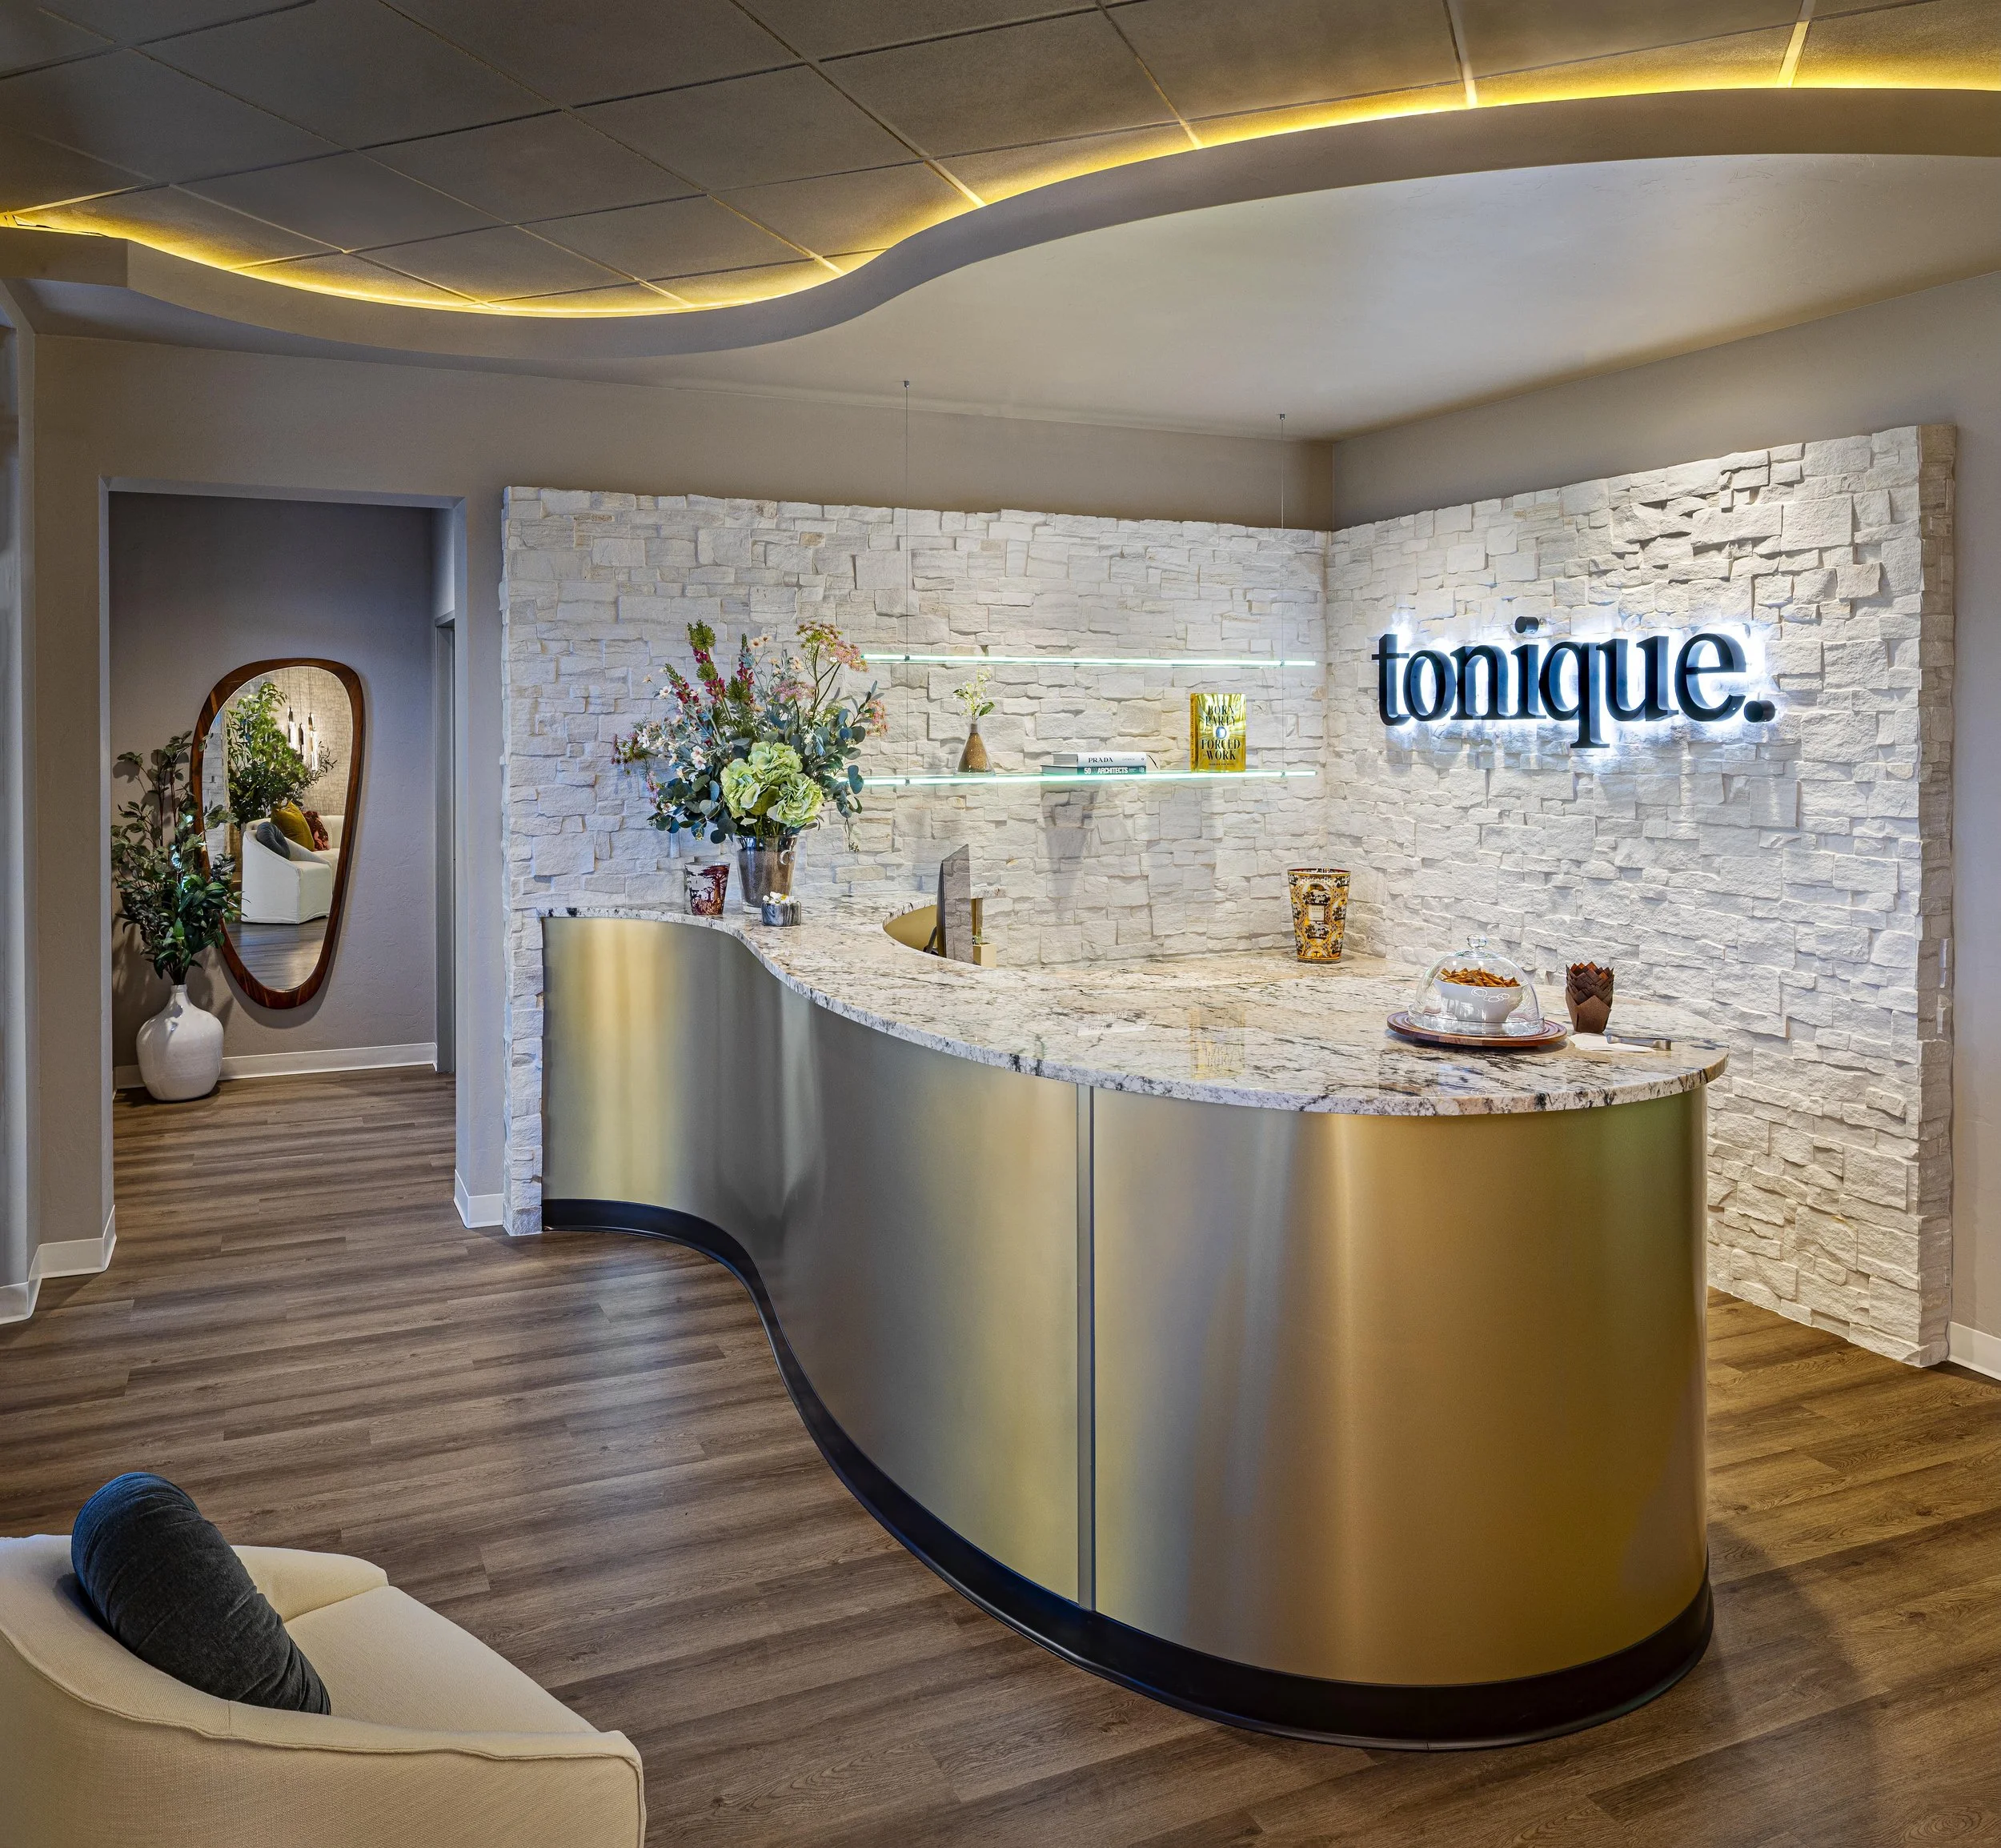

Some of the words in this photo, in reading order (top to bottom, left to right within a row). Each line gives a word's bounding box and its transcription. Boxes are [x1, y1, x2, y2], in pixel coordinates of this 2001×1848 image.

[1371, 616, 1778, 748] tonique.
[1208, 705, 1235, 716] BORN
[1205, 716, 1236, 726] PARTY
[1201, 739, 1241, 750] FORCED
[1206, 750, 1237, 760] WORK
